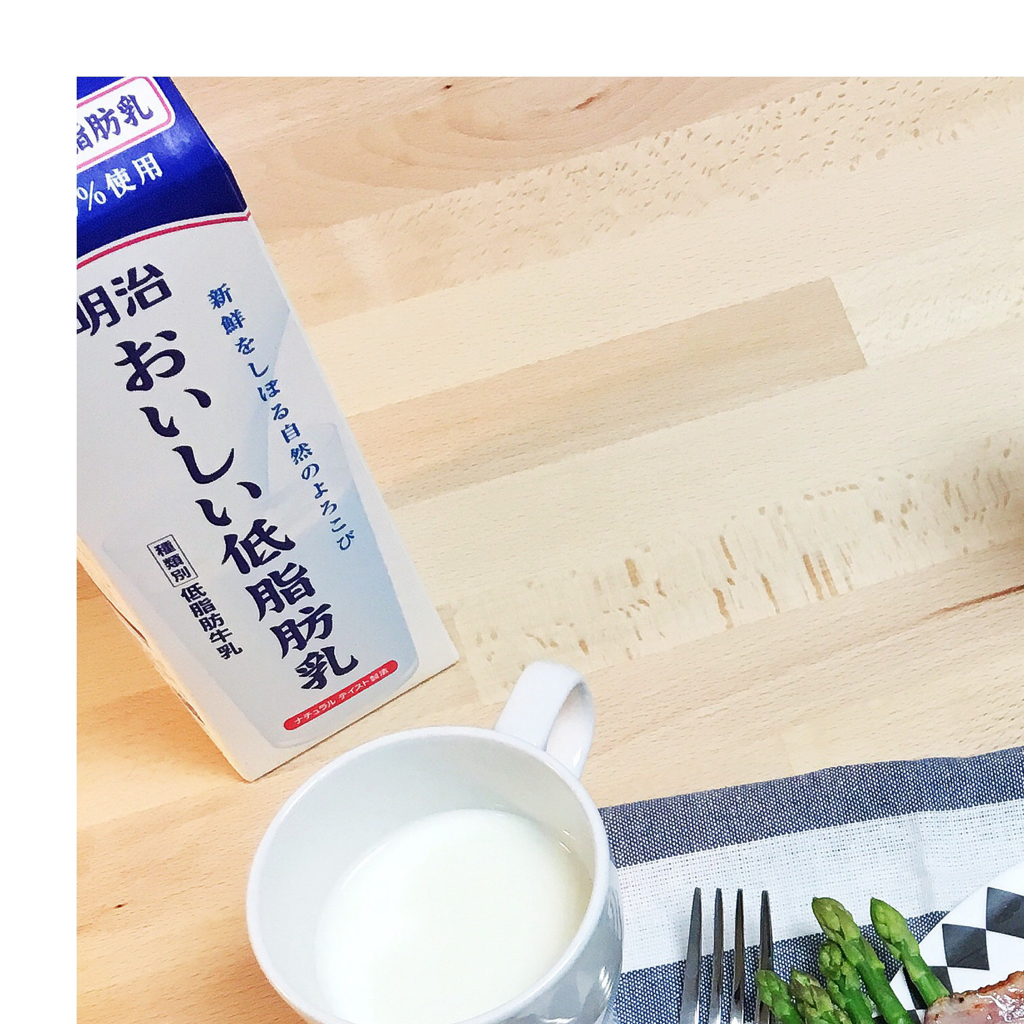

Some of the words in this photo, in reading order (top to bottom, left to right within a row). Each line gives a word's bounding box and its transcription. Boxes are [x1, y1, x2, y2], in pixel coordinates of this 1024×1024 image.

[76, 152, 164, 217] %使用
[77, 263, 172, 336] 明治
[207, 283, 355, 551] 新鮮をしぼる自然のよろこび
[113, 329, 359, 690] おいしい低脂肪乳
[154, 539, 193, 583] 種類別
[180, 583, 243, 660] 低脂肪牛乳
